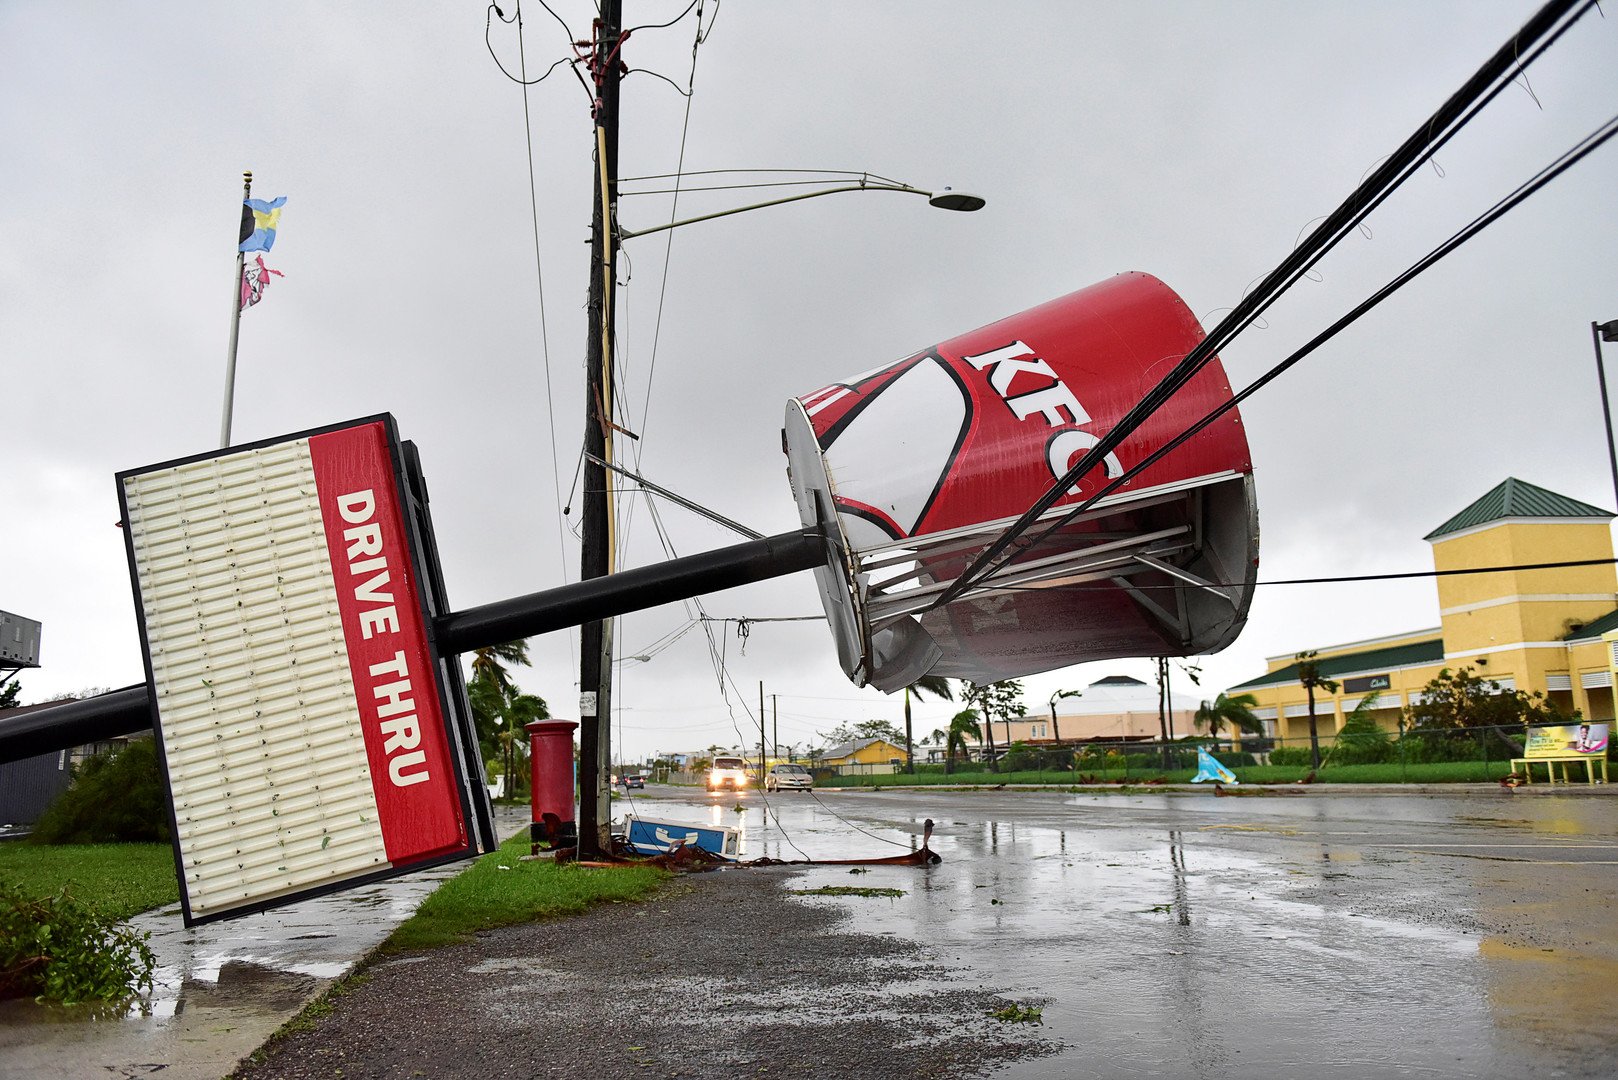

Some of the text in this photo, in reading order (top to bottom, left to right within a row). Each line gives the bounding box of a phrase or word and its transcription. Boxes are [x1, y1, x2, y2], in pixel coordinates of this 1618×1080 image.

[962, 340, 1126, 496] KFC
[337, 488, 430, 787] DRIVE THRU
